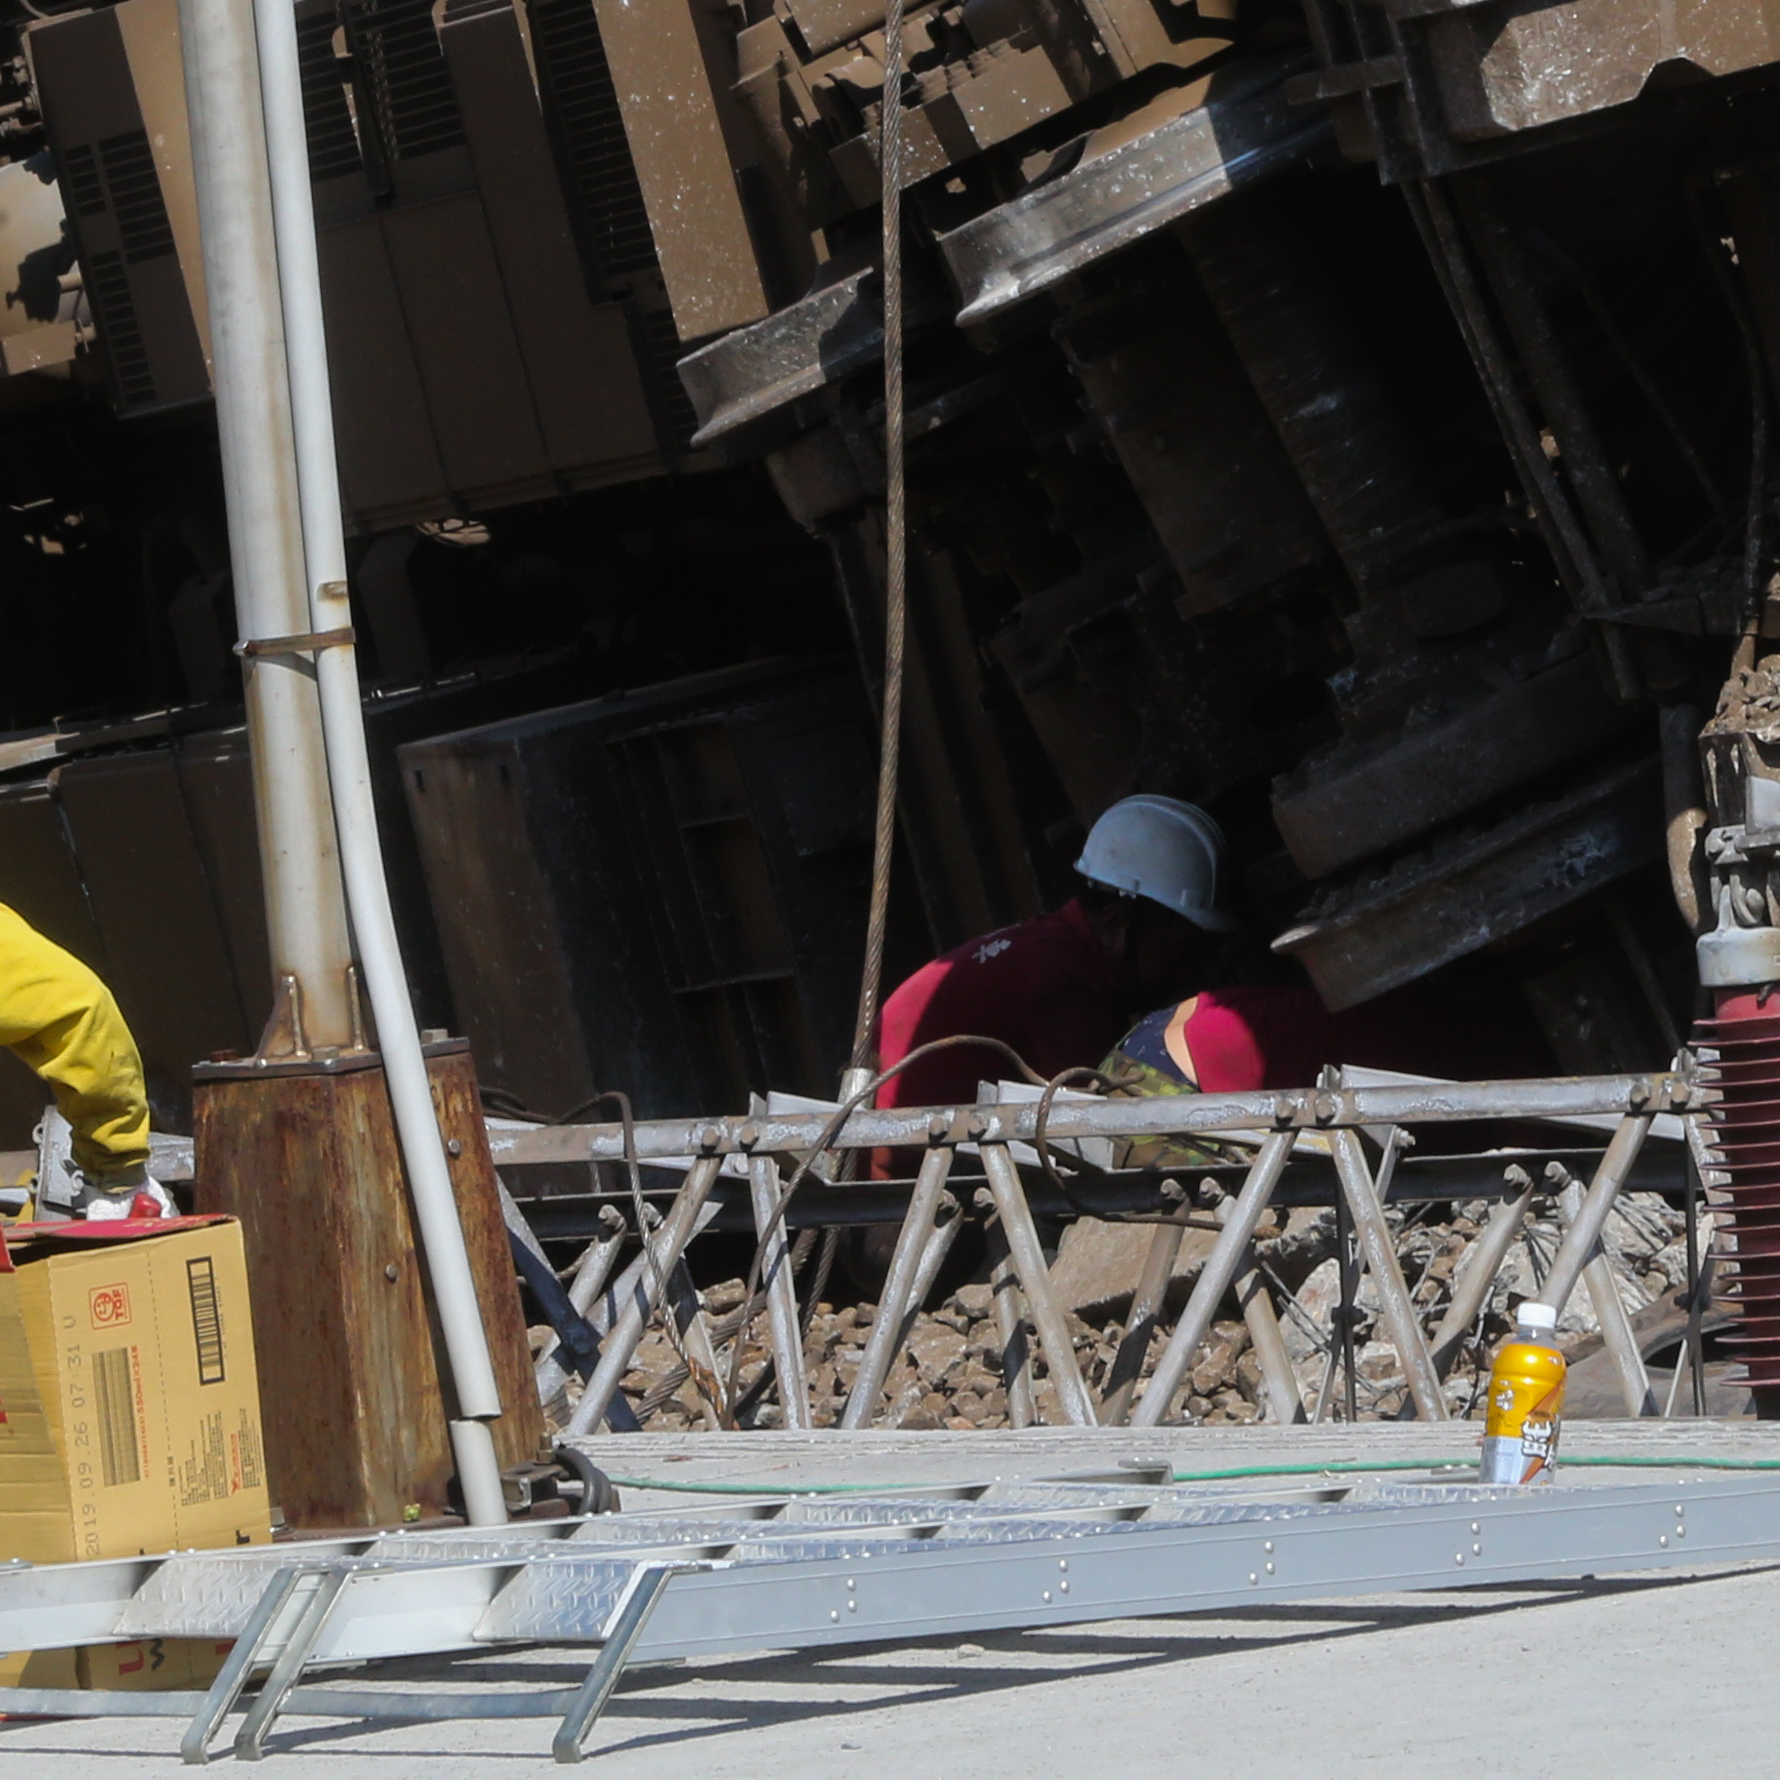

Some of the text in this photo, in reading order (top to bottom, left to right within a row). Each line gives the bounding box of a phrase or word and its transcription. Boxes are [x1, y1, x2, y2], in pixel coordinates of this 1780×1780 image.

[112, 1289, 124, 1320] TQF
[67, 1343, 86, 1408] 07:31
[74, 1421, 100, 1556] 2019.09.26
